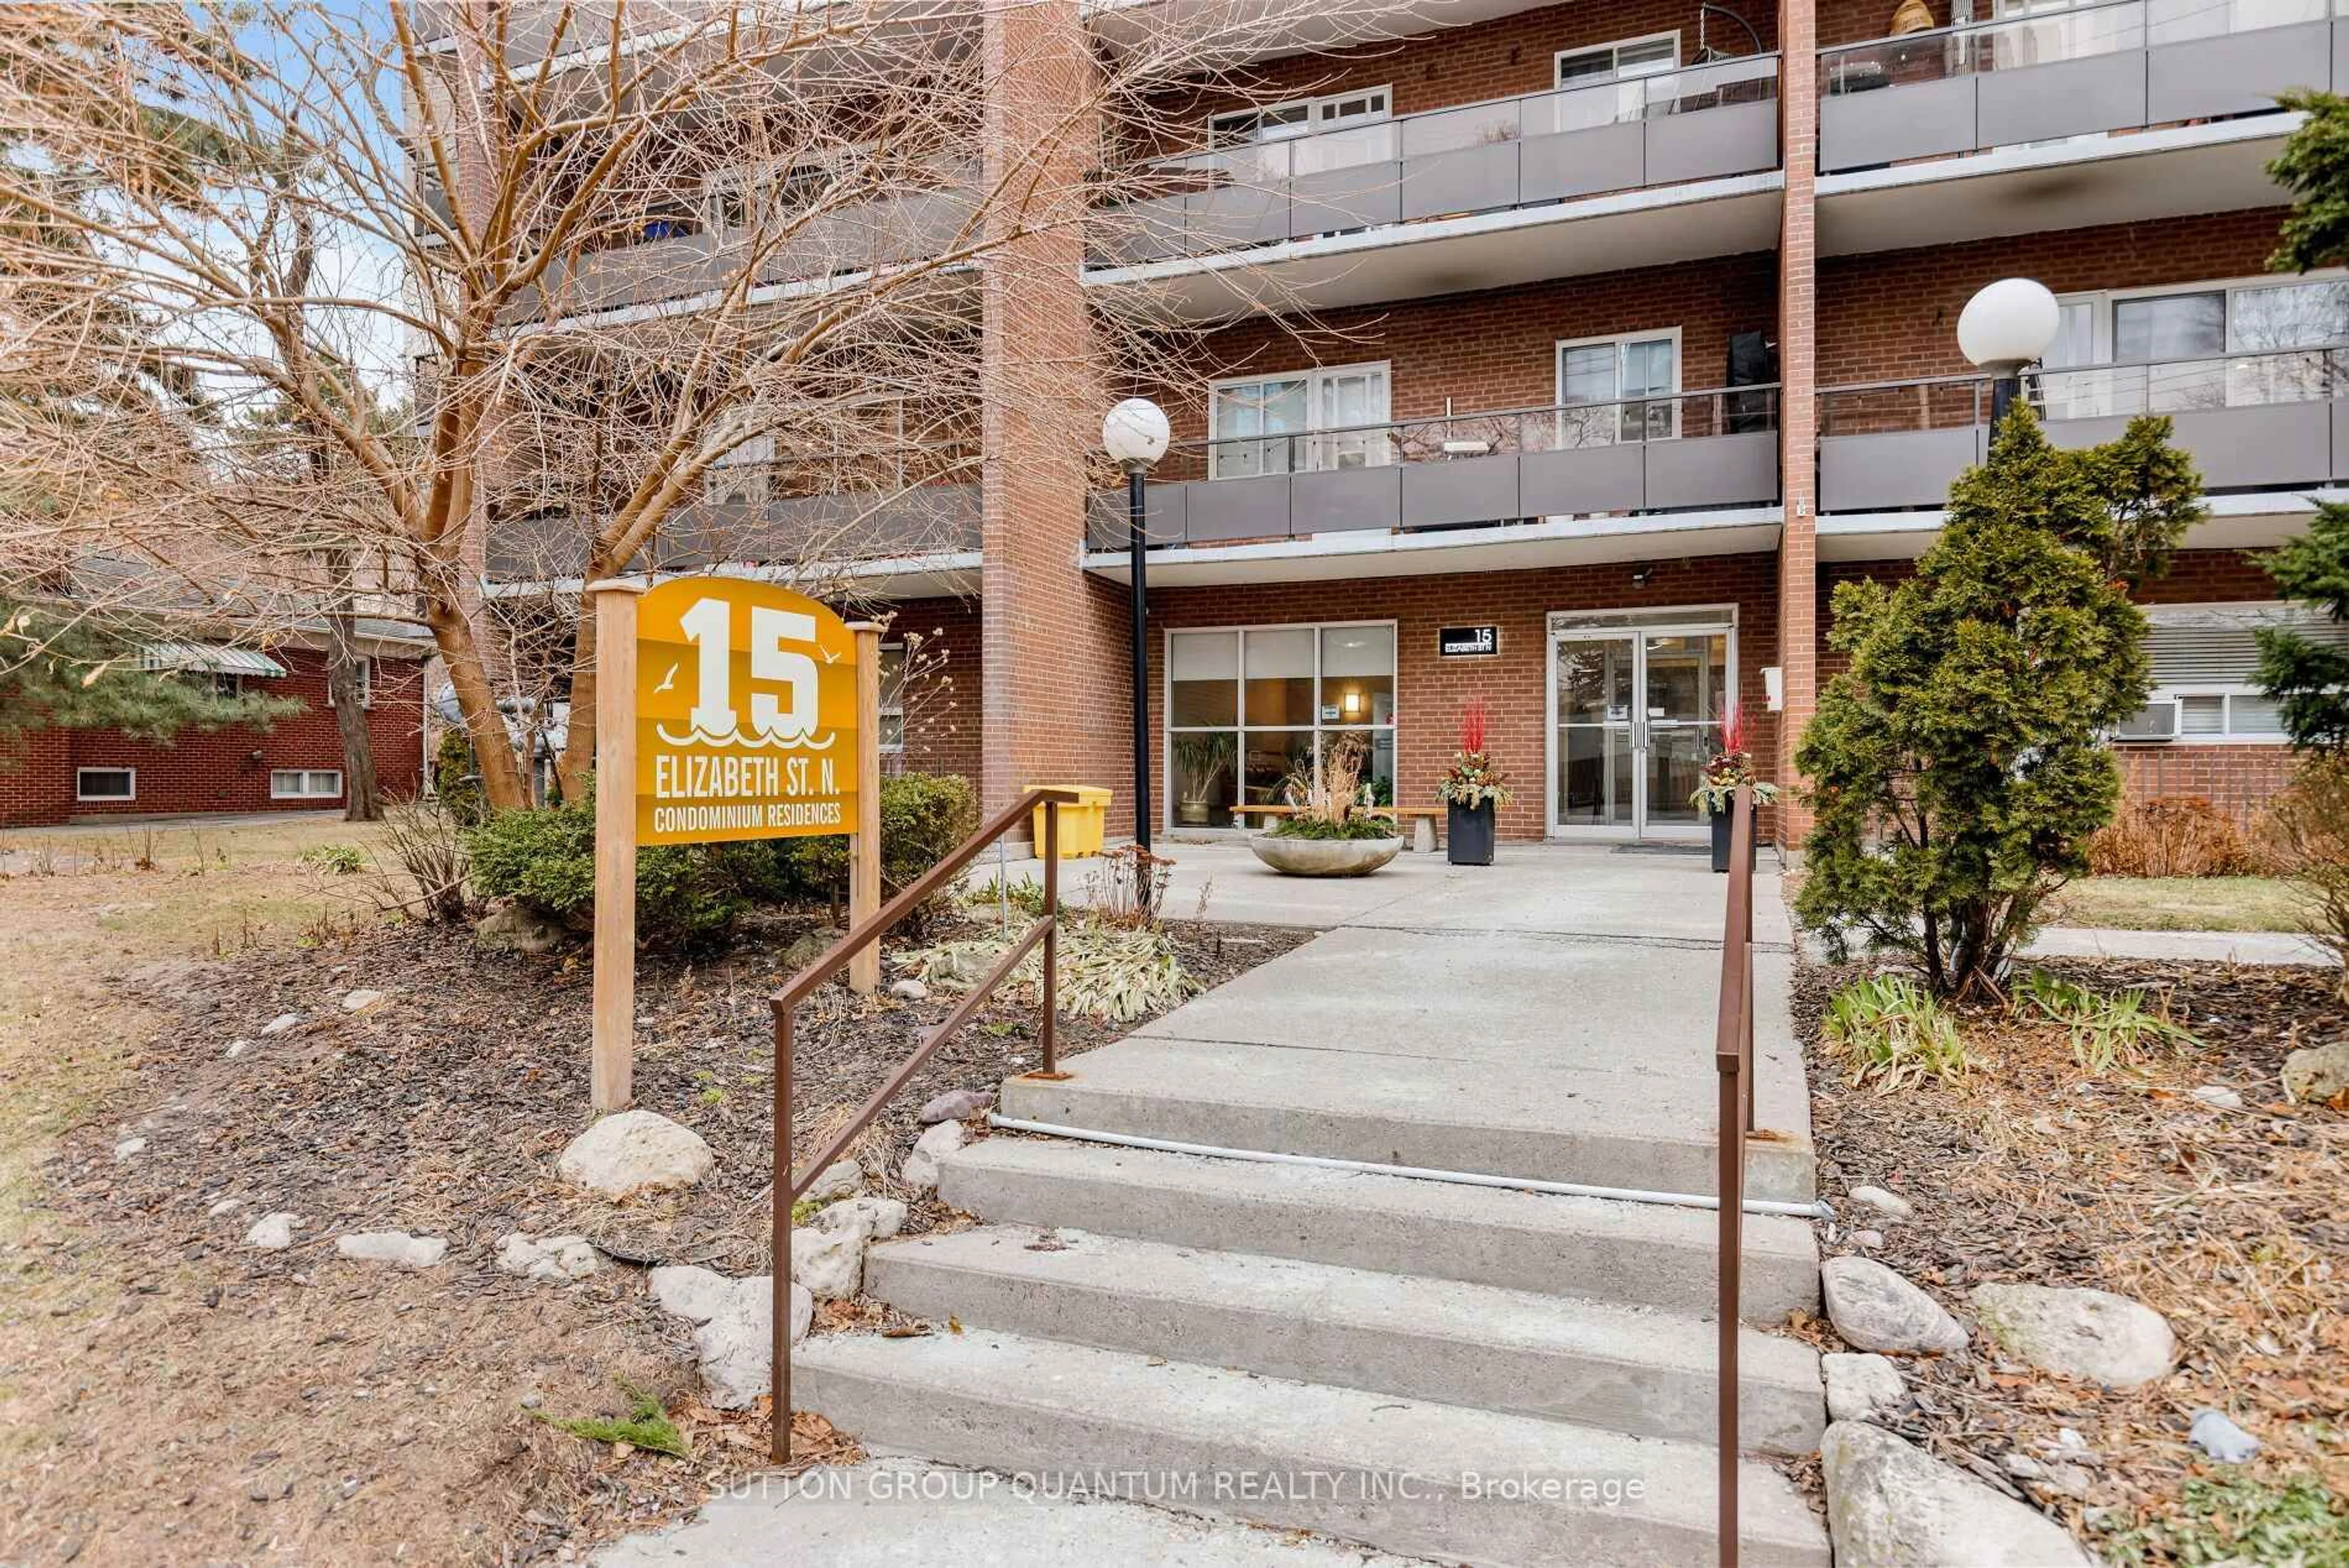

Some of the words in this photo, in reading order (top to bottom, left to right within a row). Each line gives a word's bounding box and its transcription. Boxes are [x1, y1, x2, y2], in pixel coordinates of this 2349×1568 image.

[1475, 629, 1492, 643] 15
[680, 598, 818, 738] 15
[655, 755, 779, 798] ELIZABETH
[786, 757, 814, 796] ST.
[822, 757, 841, 795] N.
[654, 804, 763, 833] CONDOMINIUM
[768, 802, 841, 827] RESIDENCES
